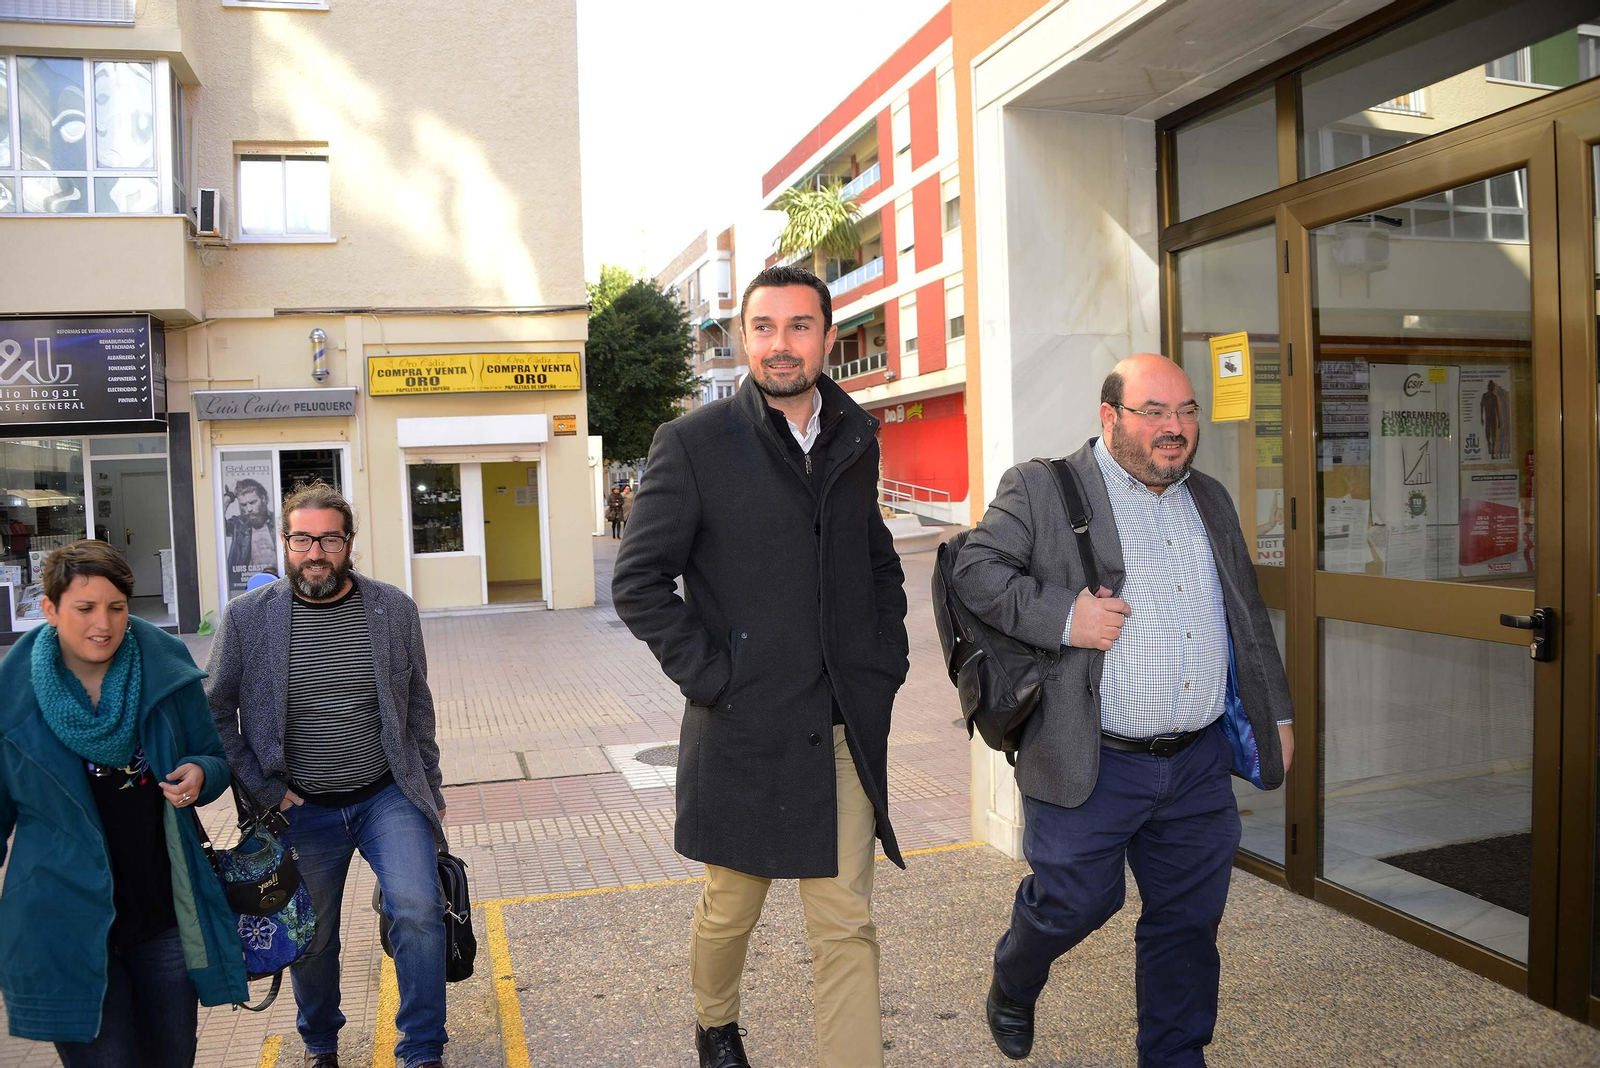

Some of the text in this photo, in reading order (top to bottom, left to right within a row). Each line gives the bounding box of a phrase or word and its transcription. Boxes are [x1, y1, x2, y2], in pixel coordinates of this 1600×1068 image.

[377, 368, 422, 377] COMPRA
[435, 367, 467, 375] VENTA
[487, 365, 531, 373] COMPRA
[541, 364, 572, 372] VENTA
[405, 376, 440, 387] ORO
[514, 373, 547, 384] ORO
[1407, 380, 1424, 389] CSIF
[30, 388, 77, 399] hogar
[15, 403, 29, 411] EN
[33, 402, 85, 410] GENERAL
[200, 393, 352, 414] Luis Castro PELUQUERO
[1391, 410, 1446, 419] INCREMENTO
[1381, 417, 1450, 426] COMPLEMENTO
[1465, 437, 1480, 449] STAJ
[1257, 540, 1279, 549] UGT
[1257, 550, 1284, 559] NO
